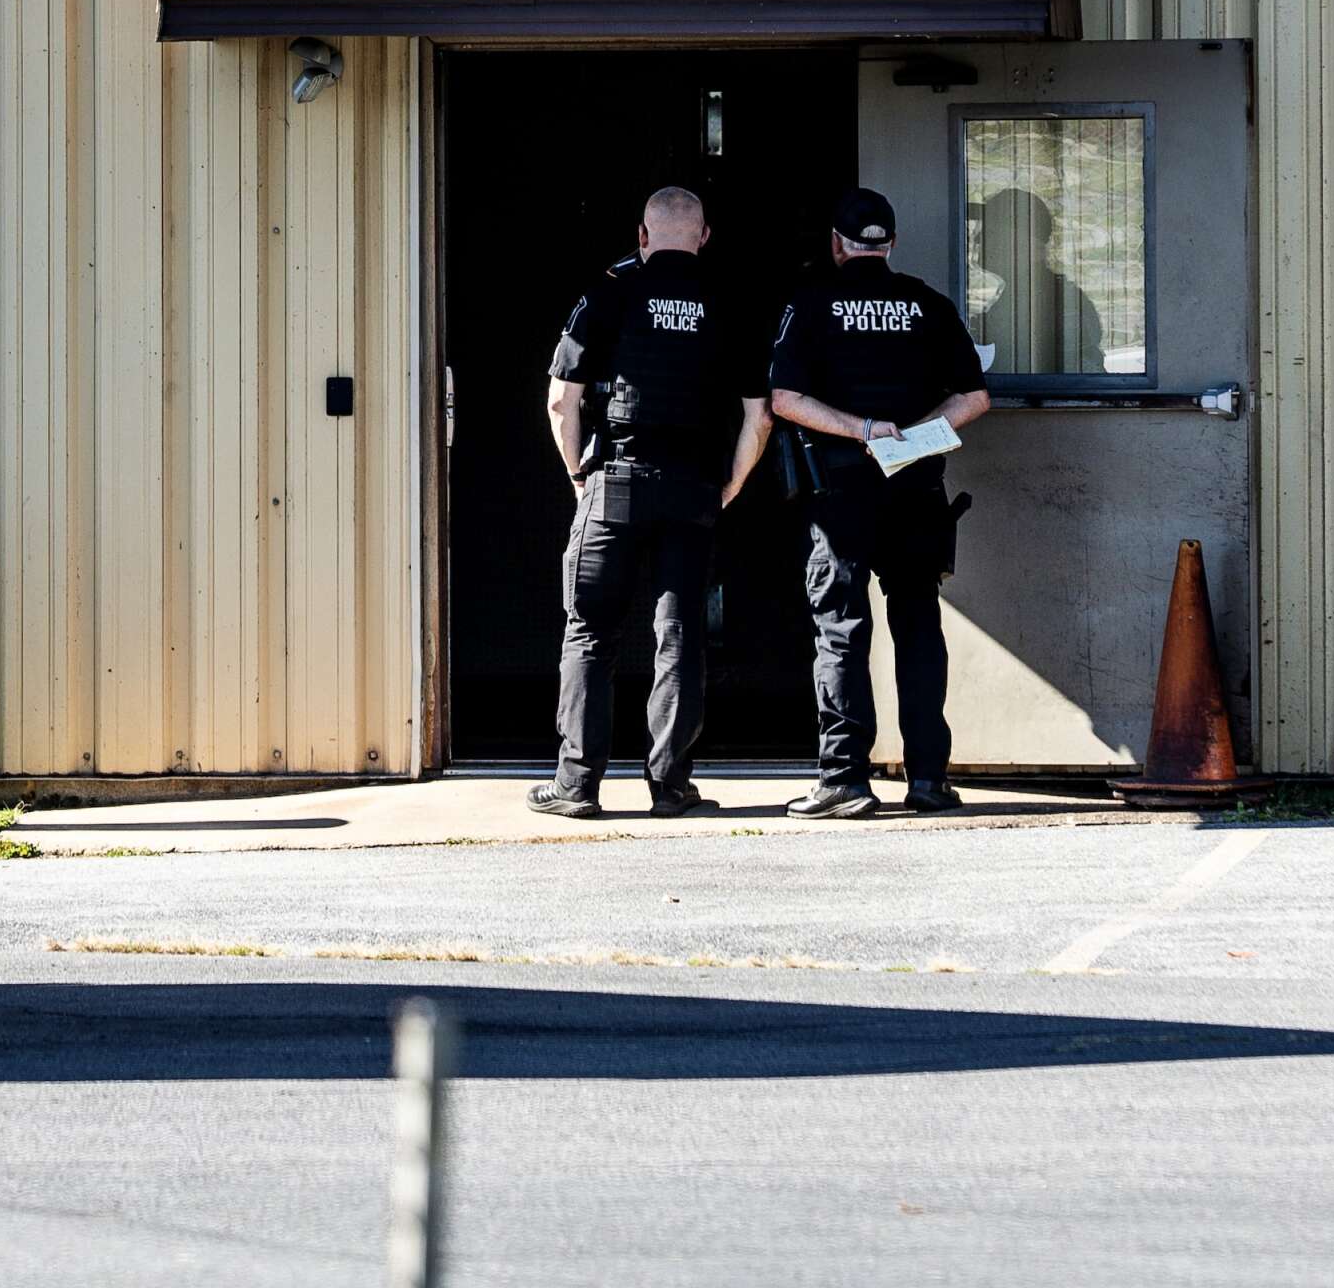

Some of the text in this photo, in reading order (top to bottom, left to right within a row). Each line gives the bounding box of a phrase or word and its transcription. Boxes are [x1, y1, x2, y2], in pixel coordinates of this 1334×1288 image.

[648, 299, 705, 318] SWATARA
[832, 300, 923, 317] SWATARA
[653, 314, 698, 332] POLICE
[843, 315, 911, 331] POLICE
